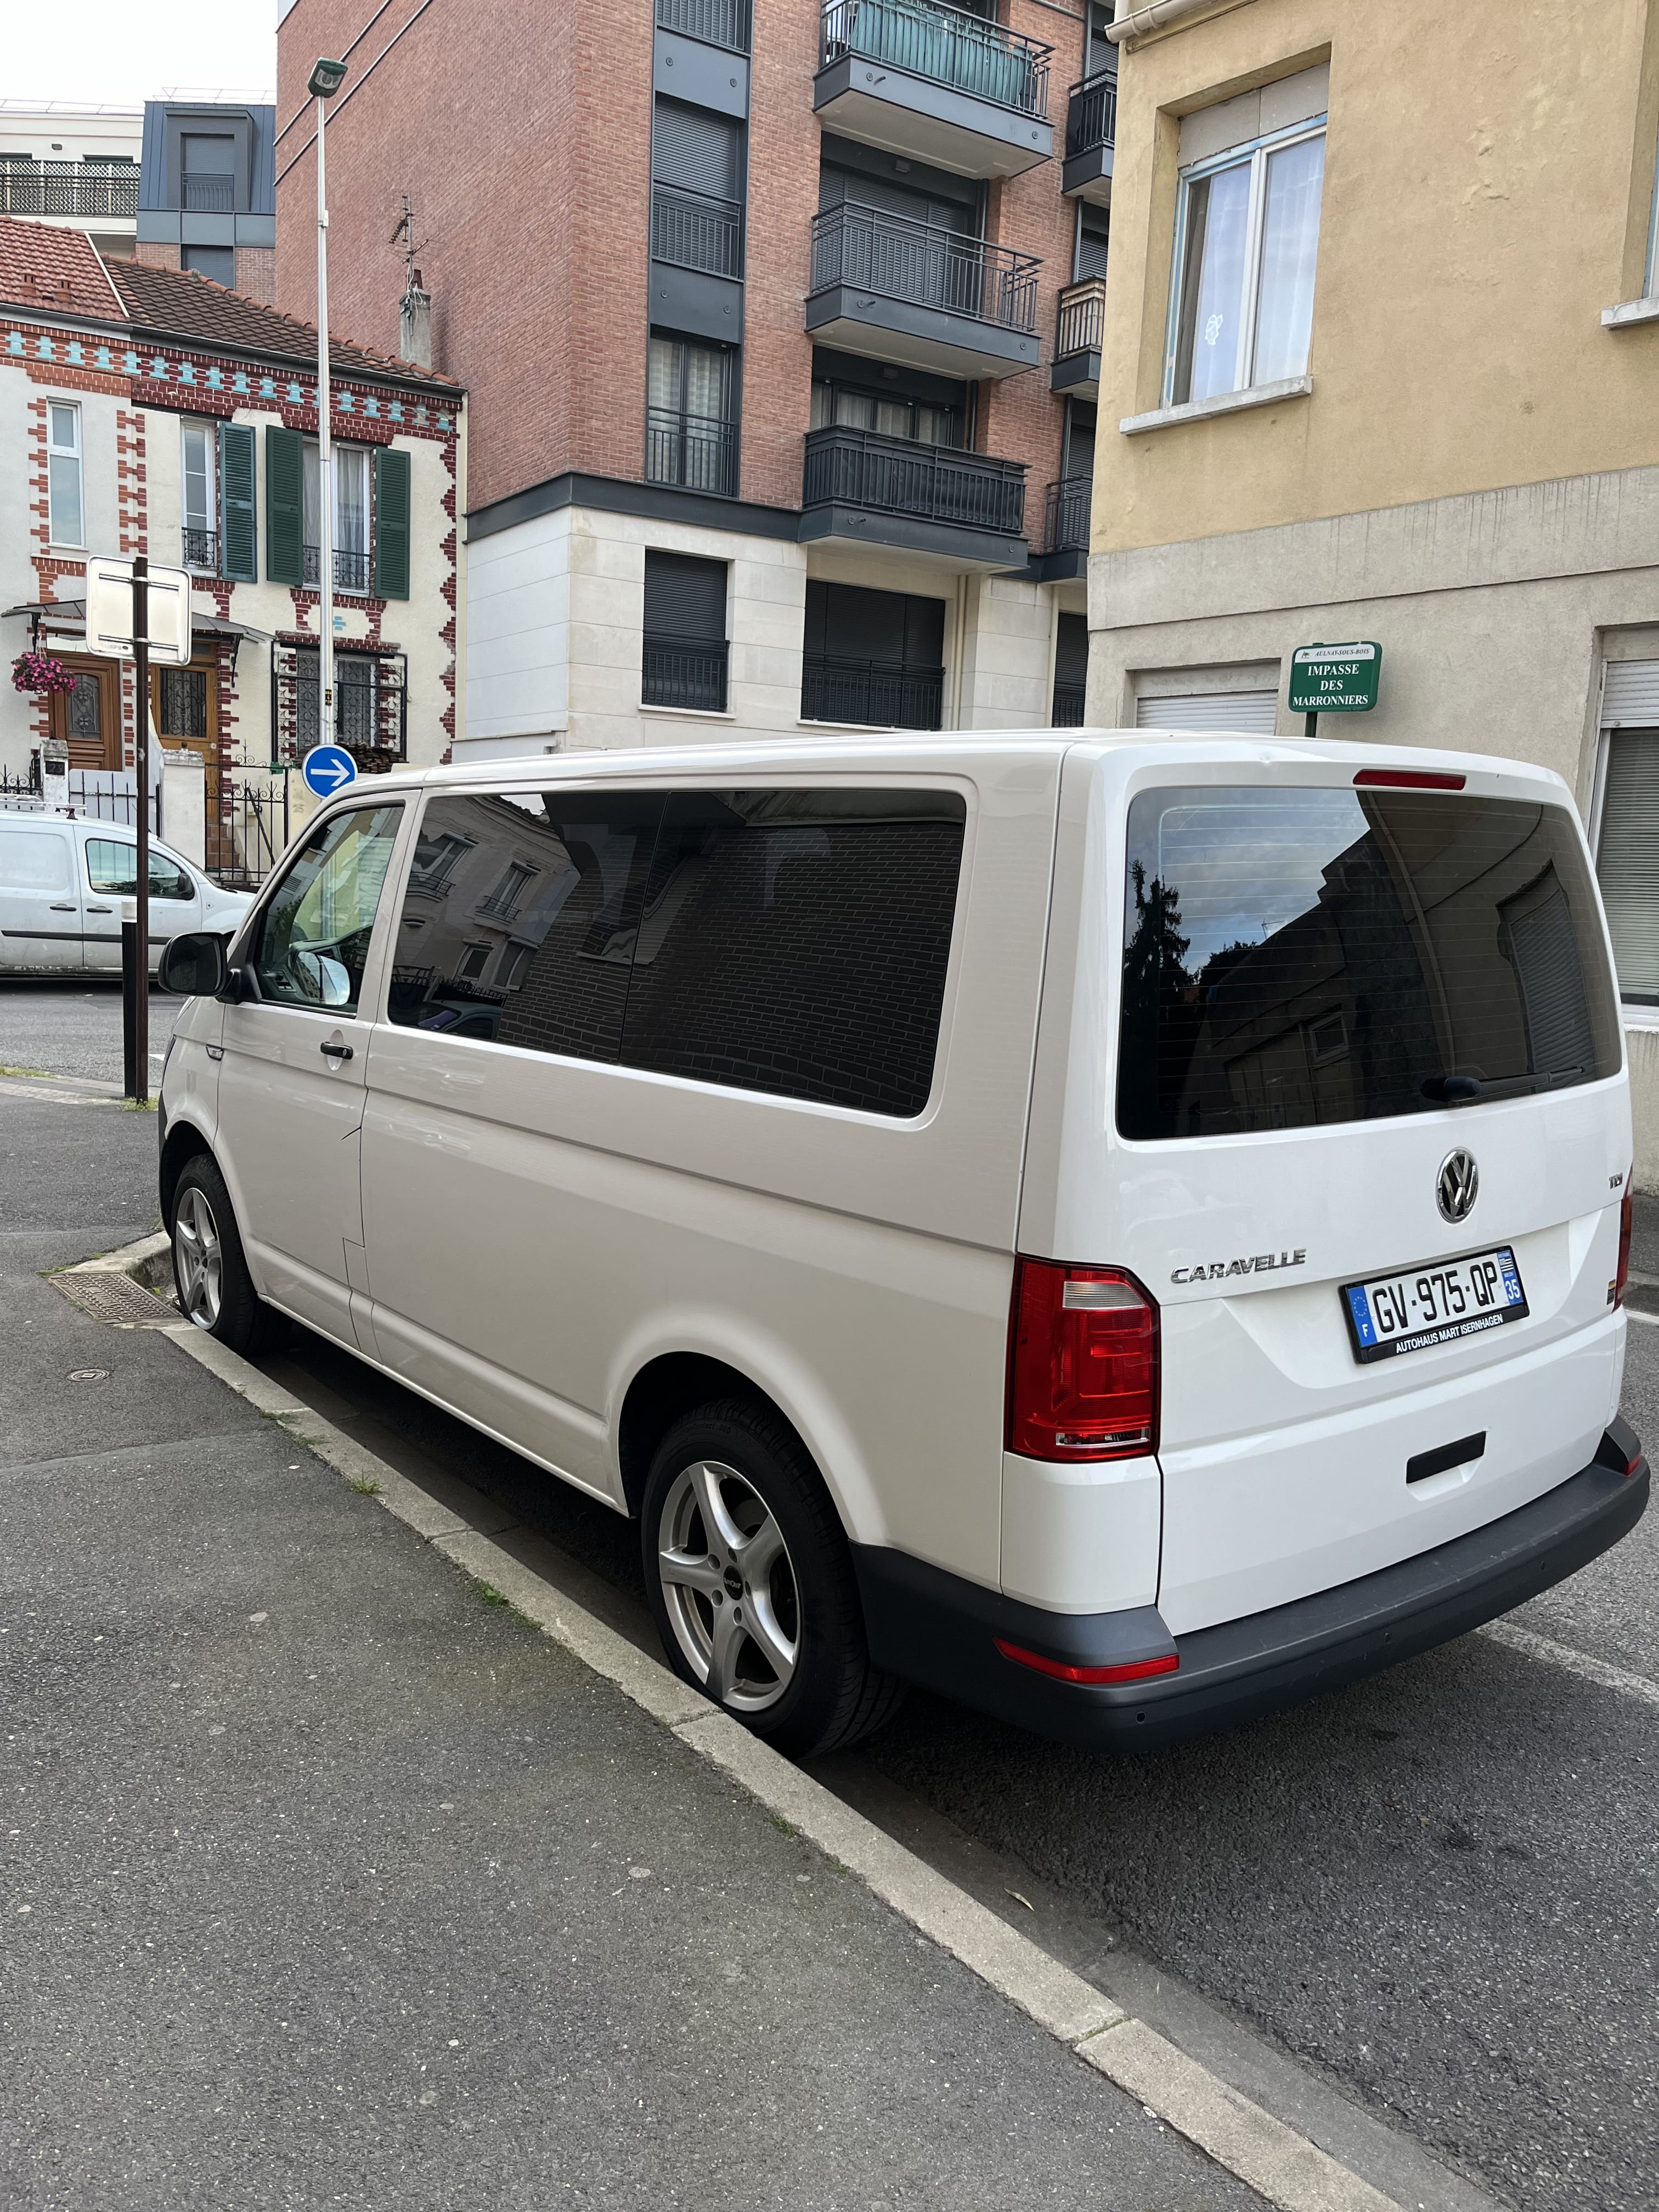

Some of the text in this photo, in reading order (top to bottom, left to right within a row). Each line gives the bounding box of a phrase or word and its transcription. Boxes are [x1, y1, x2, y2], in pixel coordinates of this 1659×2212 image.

[1315, 648, 1370, 657] AULNAY-SOUS-BOIS
[1307, 664, 1359, 676] IMPASSE
[1320, 680, 1344, 691] DES
[1293, 695, 1369, 706] MARRONNIERS
[1170, 1248, 1307, 1284] CARAVELLE
[1505, 1279, 1520, 1300] 35
[1362, 1323, 1369, 1338] F
[1396, 1313, 1504, 1353] AUTOHAUS MART ISERNHAGEN
